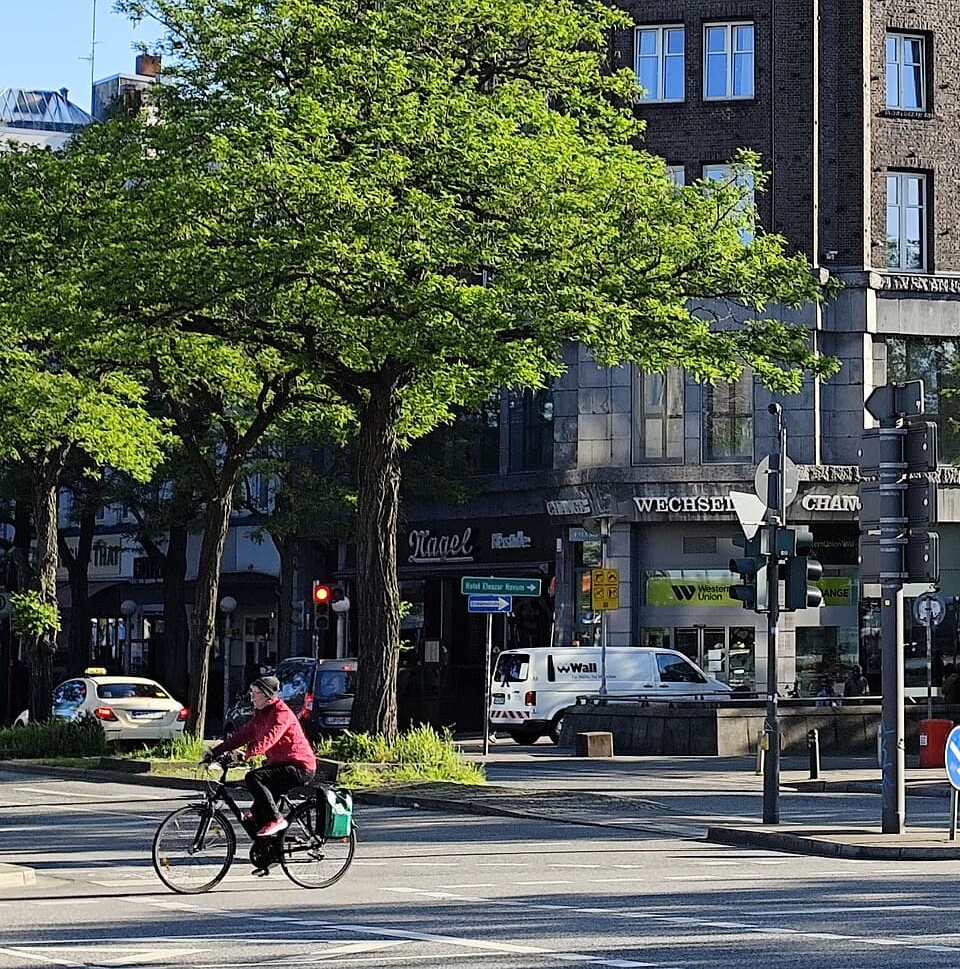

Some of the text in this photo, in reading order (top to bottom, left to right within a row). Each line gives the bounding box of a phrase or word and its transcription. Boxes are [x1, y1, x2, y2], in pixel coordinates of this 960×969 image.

[408, 527, 473, 557] Nagel
[465, 581, 480, 590] Hotel
[697, 593, 723, 601] Union
[570, 662, 598, 673] Wall
